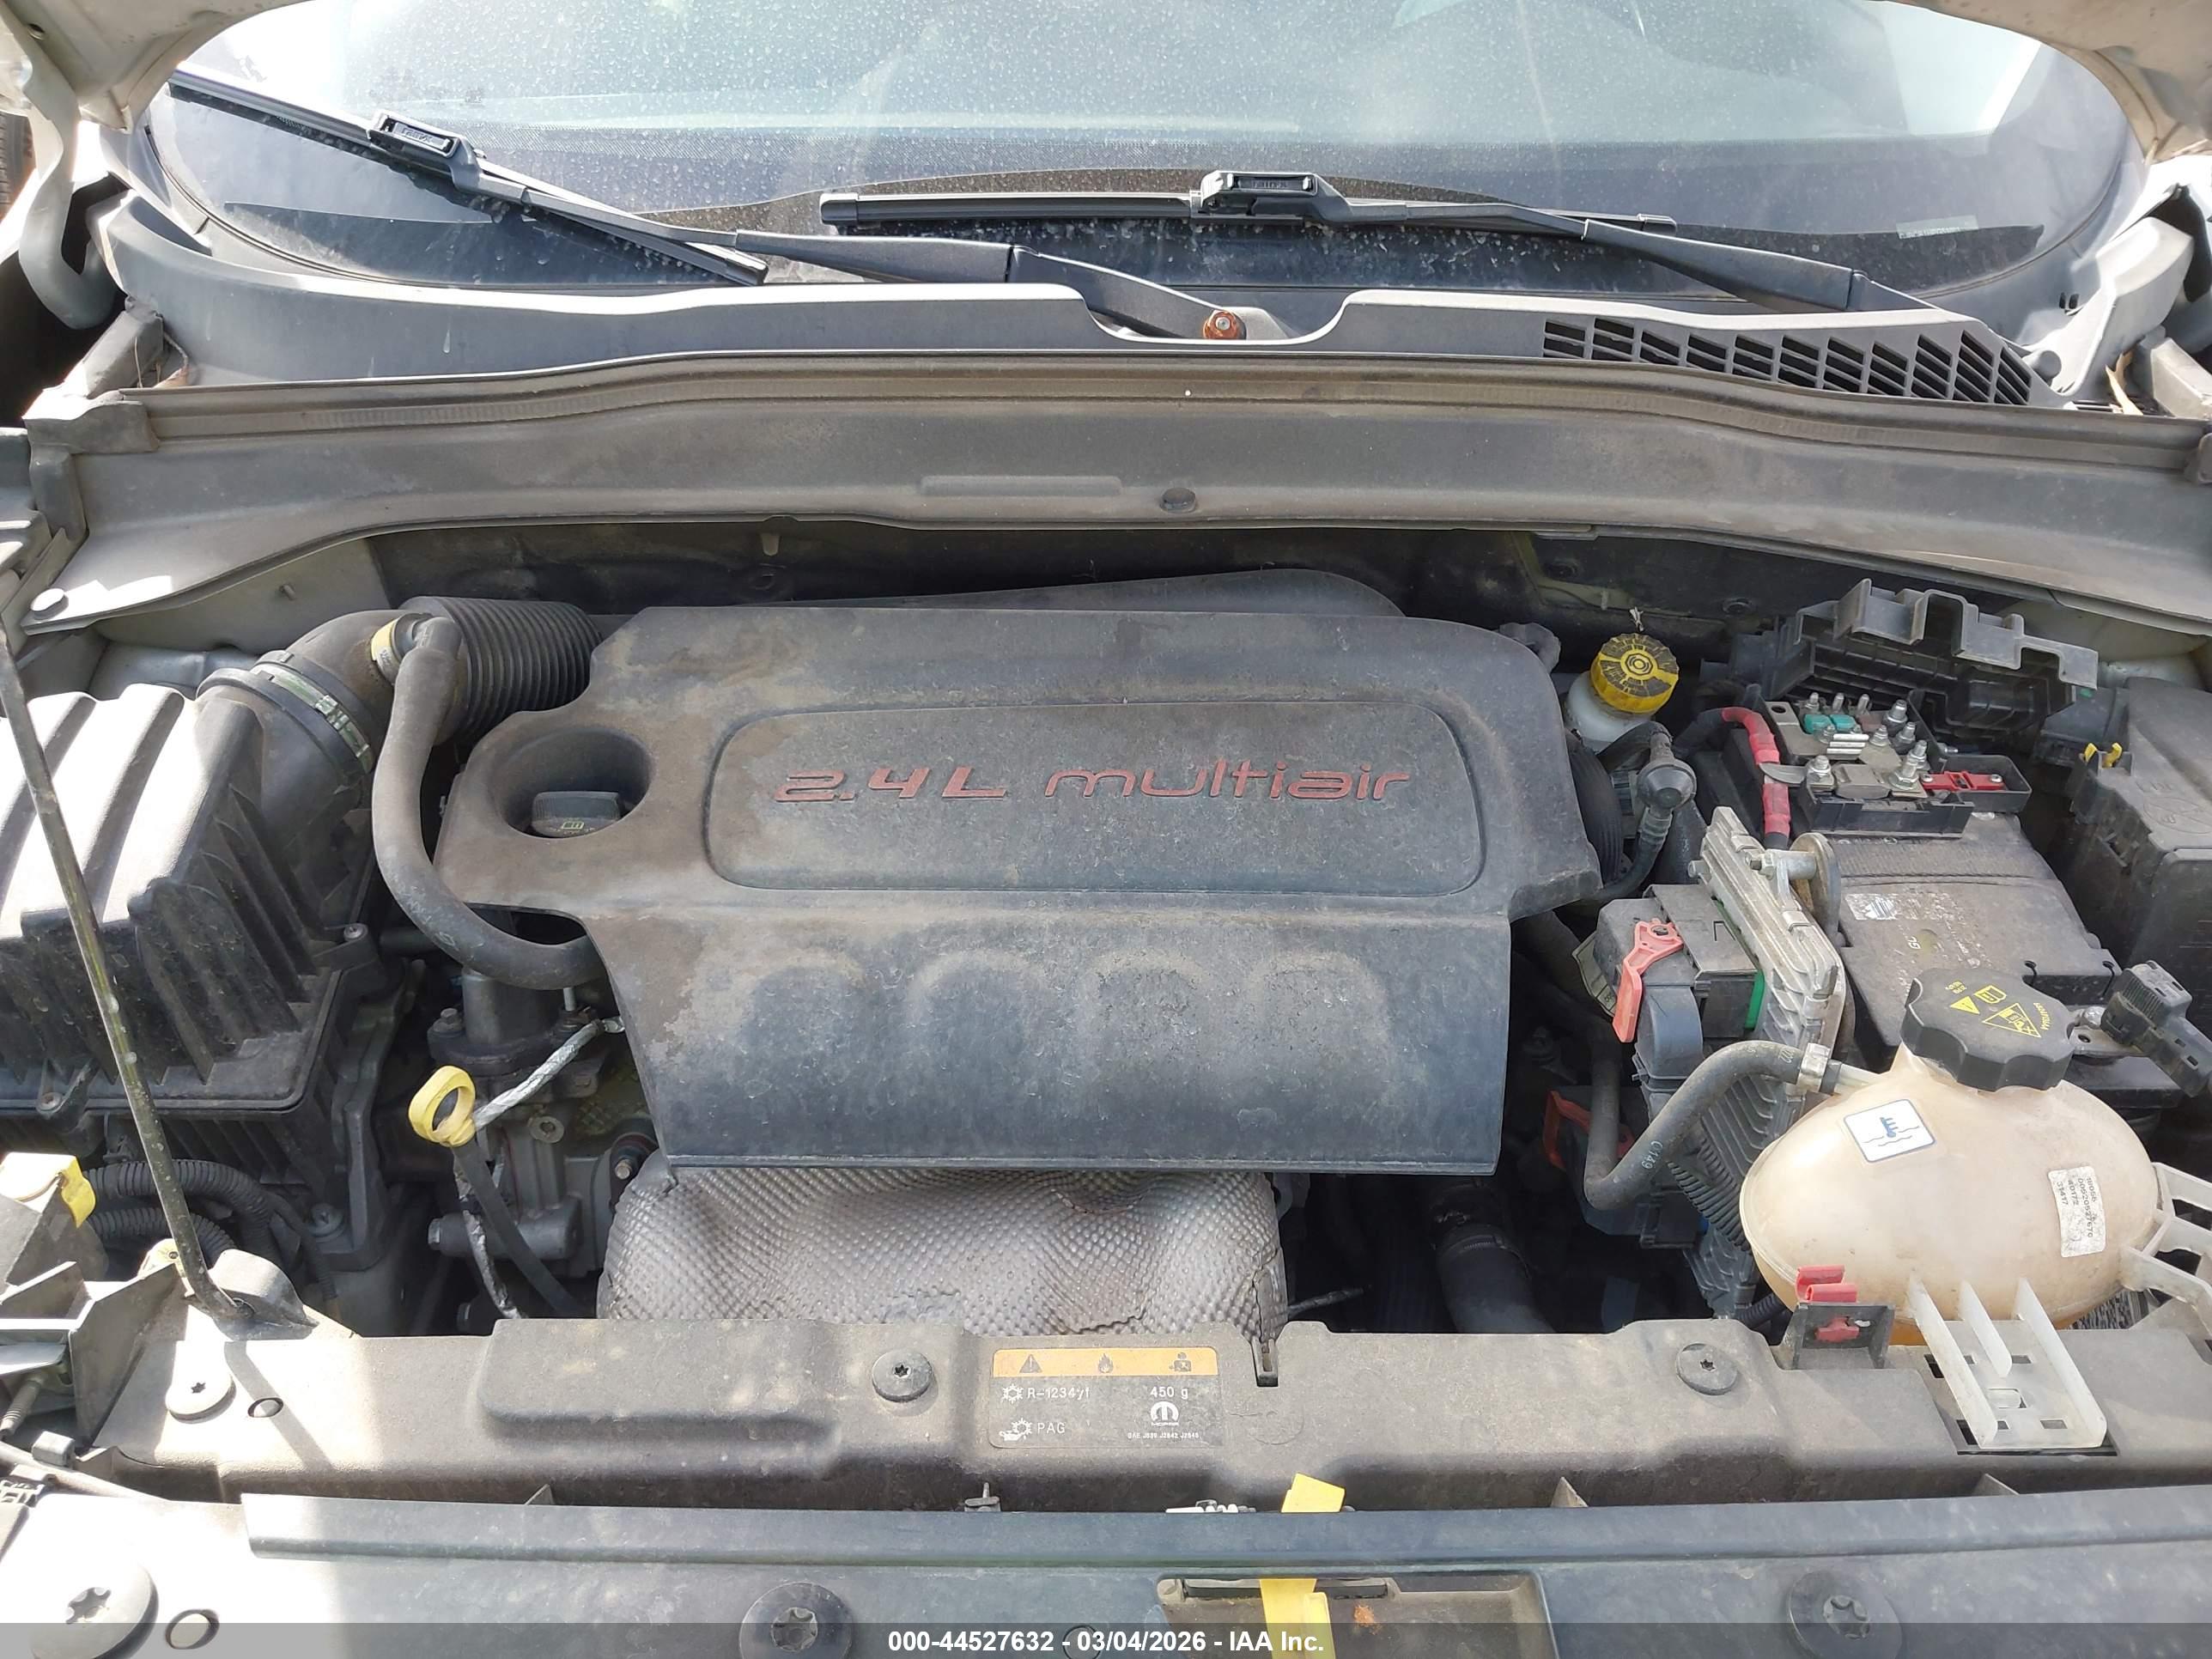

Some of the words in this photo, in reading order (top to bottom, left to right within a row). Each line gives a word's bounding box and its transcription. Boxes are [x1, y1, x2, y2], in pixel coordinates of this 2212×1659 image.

[775, 765, 1006, 803] 2.4L
[1044, 758, 1409, 799] multiair
[1027, 1387, 1090, 1401] R-1234yf
[1150, 1387, 1174, 1397] 450
[1181, 1388, 1189, 1399] g
[1037, 1422, 1066, 1433] PAG
